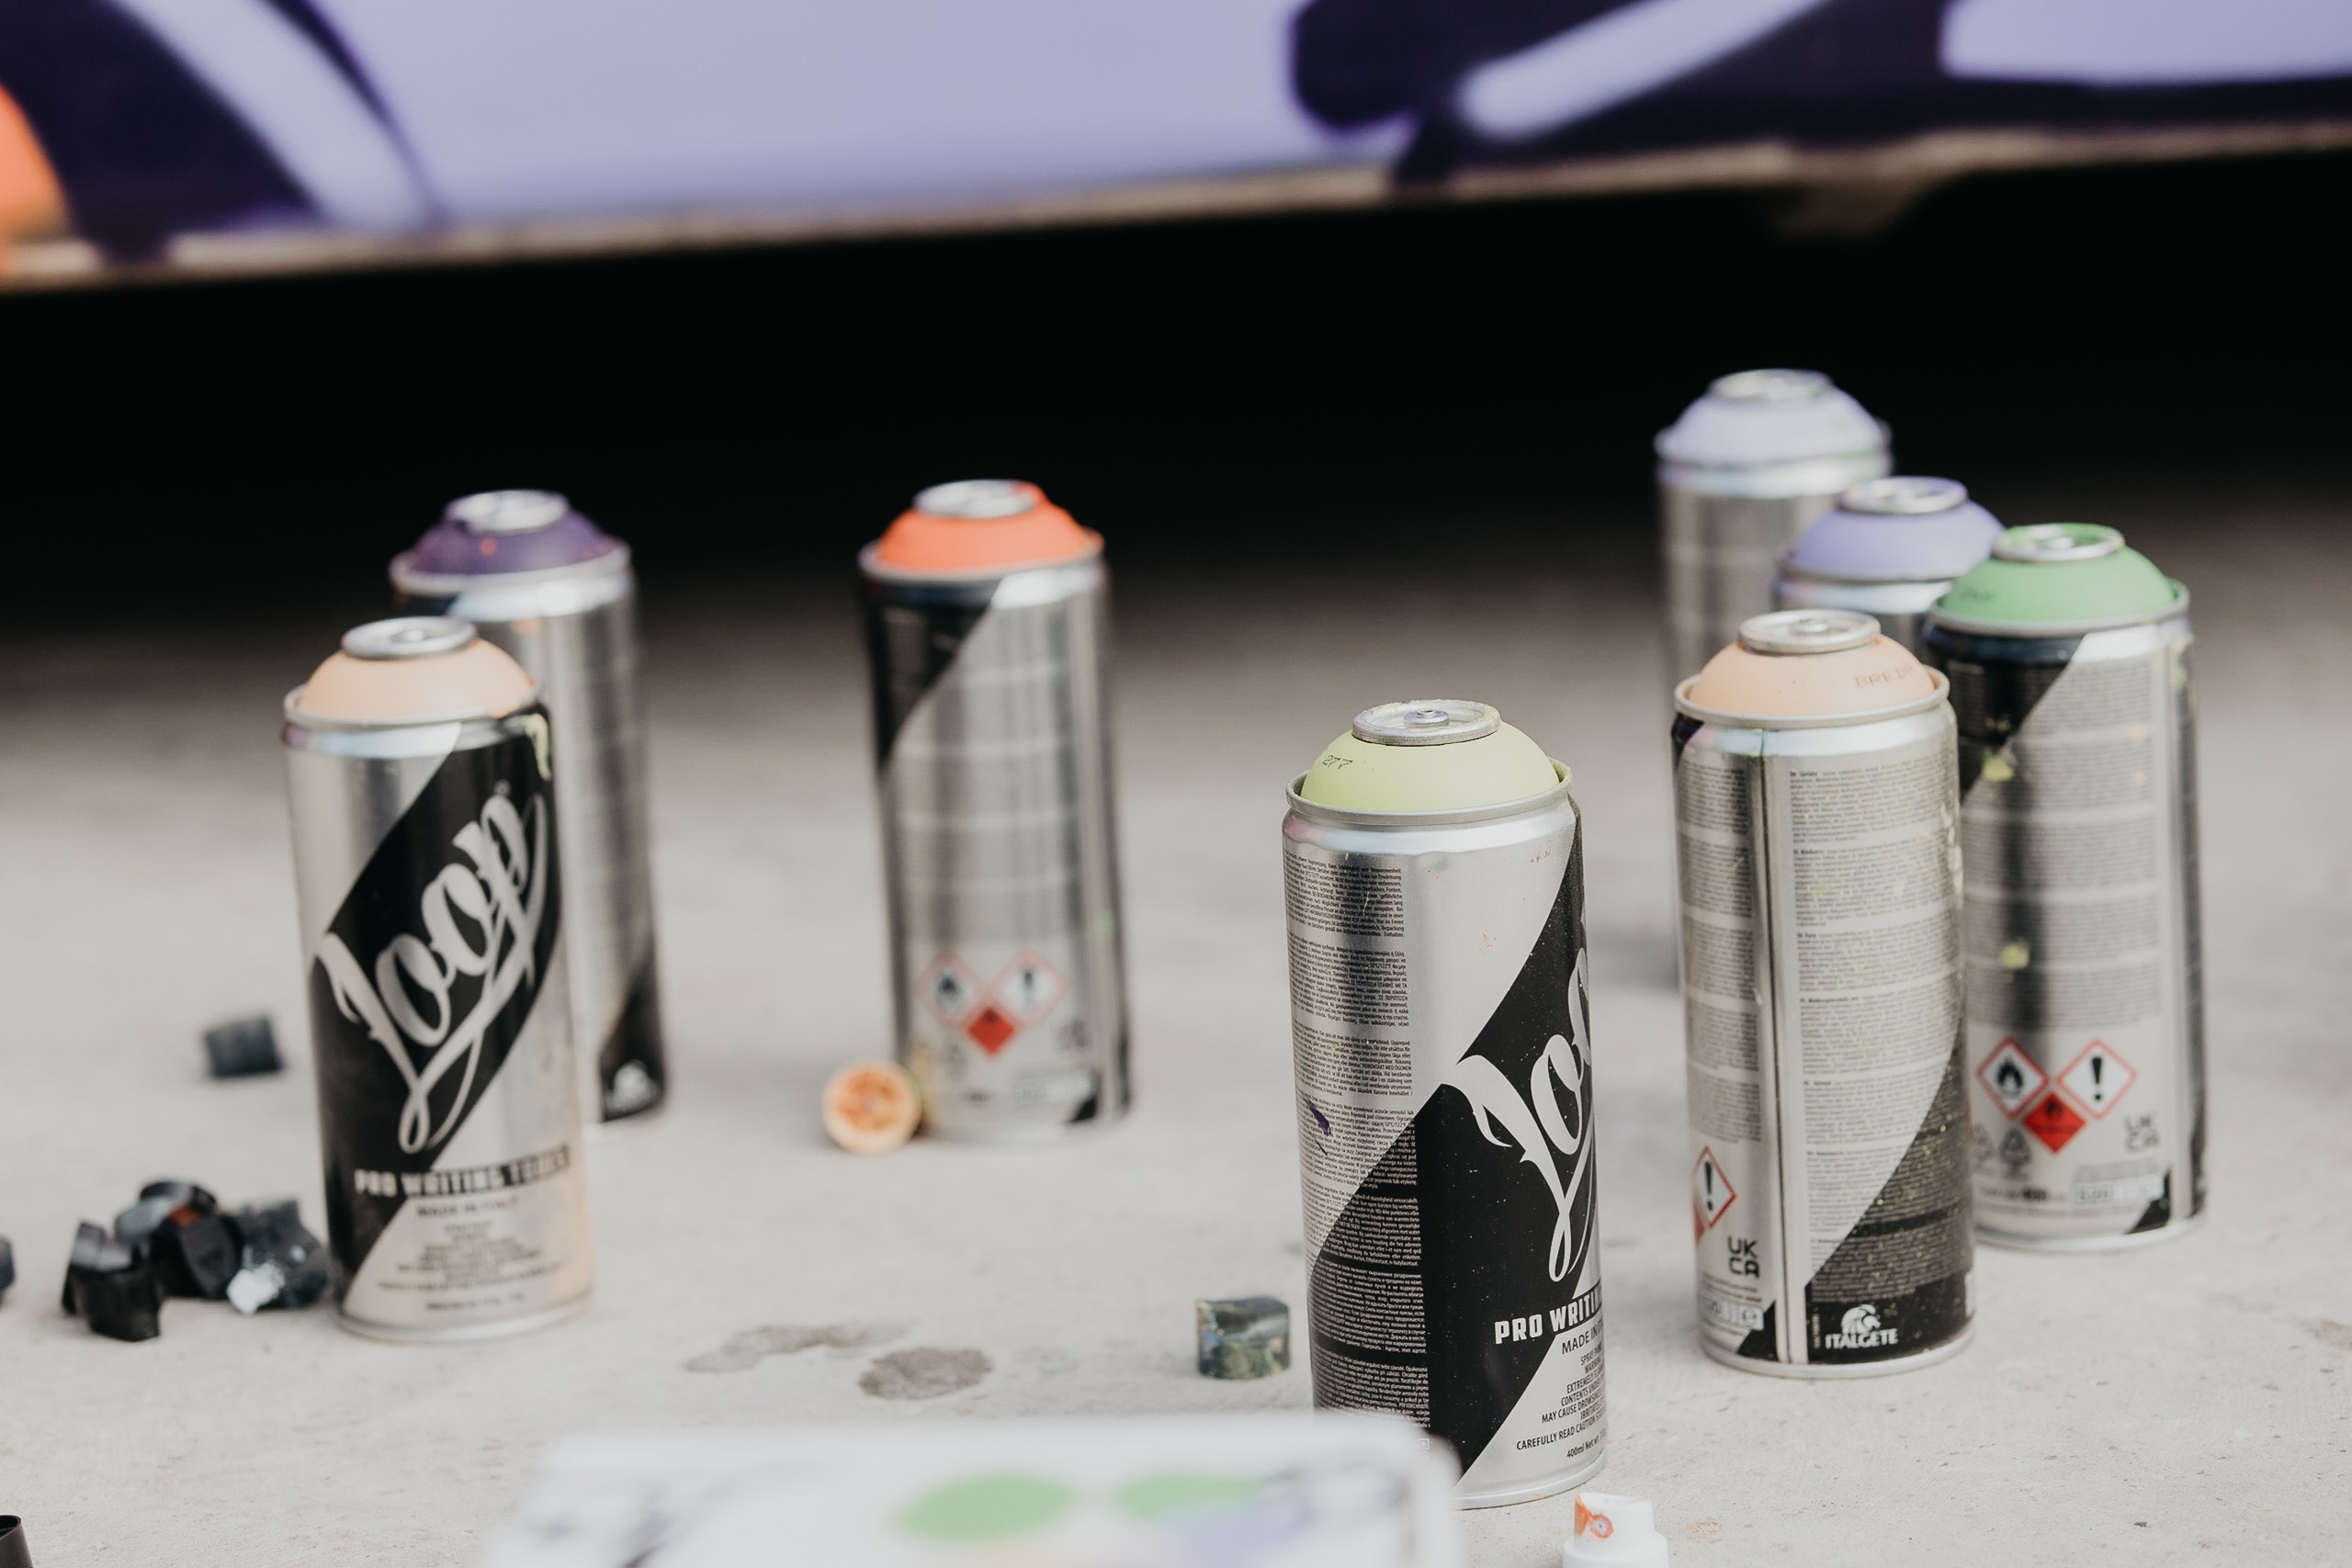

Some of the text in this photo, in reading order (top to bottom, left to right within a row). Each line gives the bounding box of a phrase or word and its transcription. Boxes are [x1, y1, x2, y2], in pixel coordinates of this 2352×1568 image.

[1322, 755, 1353, 770] 277
[1727, 1236, 1758, 1258] UK
[1729, 1257, 1760, 1279] CA
[1495, 1314, 1543, 1345] PRO
[1825, 1328, 1900, 1349] ITALGETE
[1562, 1331, 1590, 1355] MADE
[1542, 1411, 1557, 1423] MAY
[1557, 1404, 1577, 1418] CAUSE
[1516, 1432, 1558, 1450] CAREFULLY
[1558, 1427, 1575, 1439] READ
